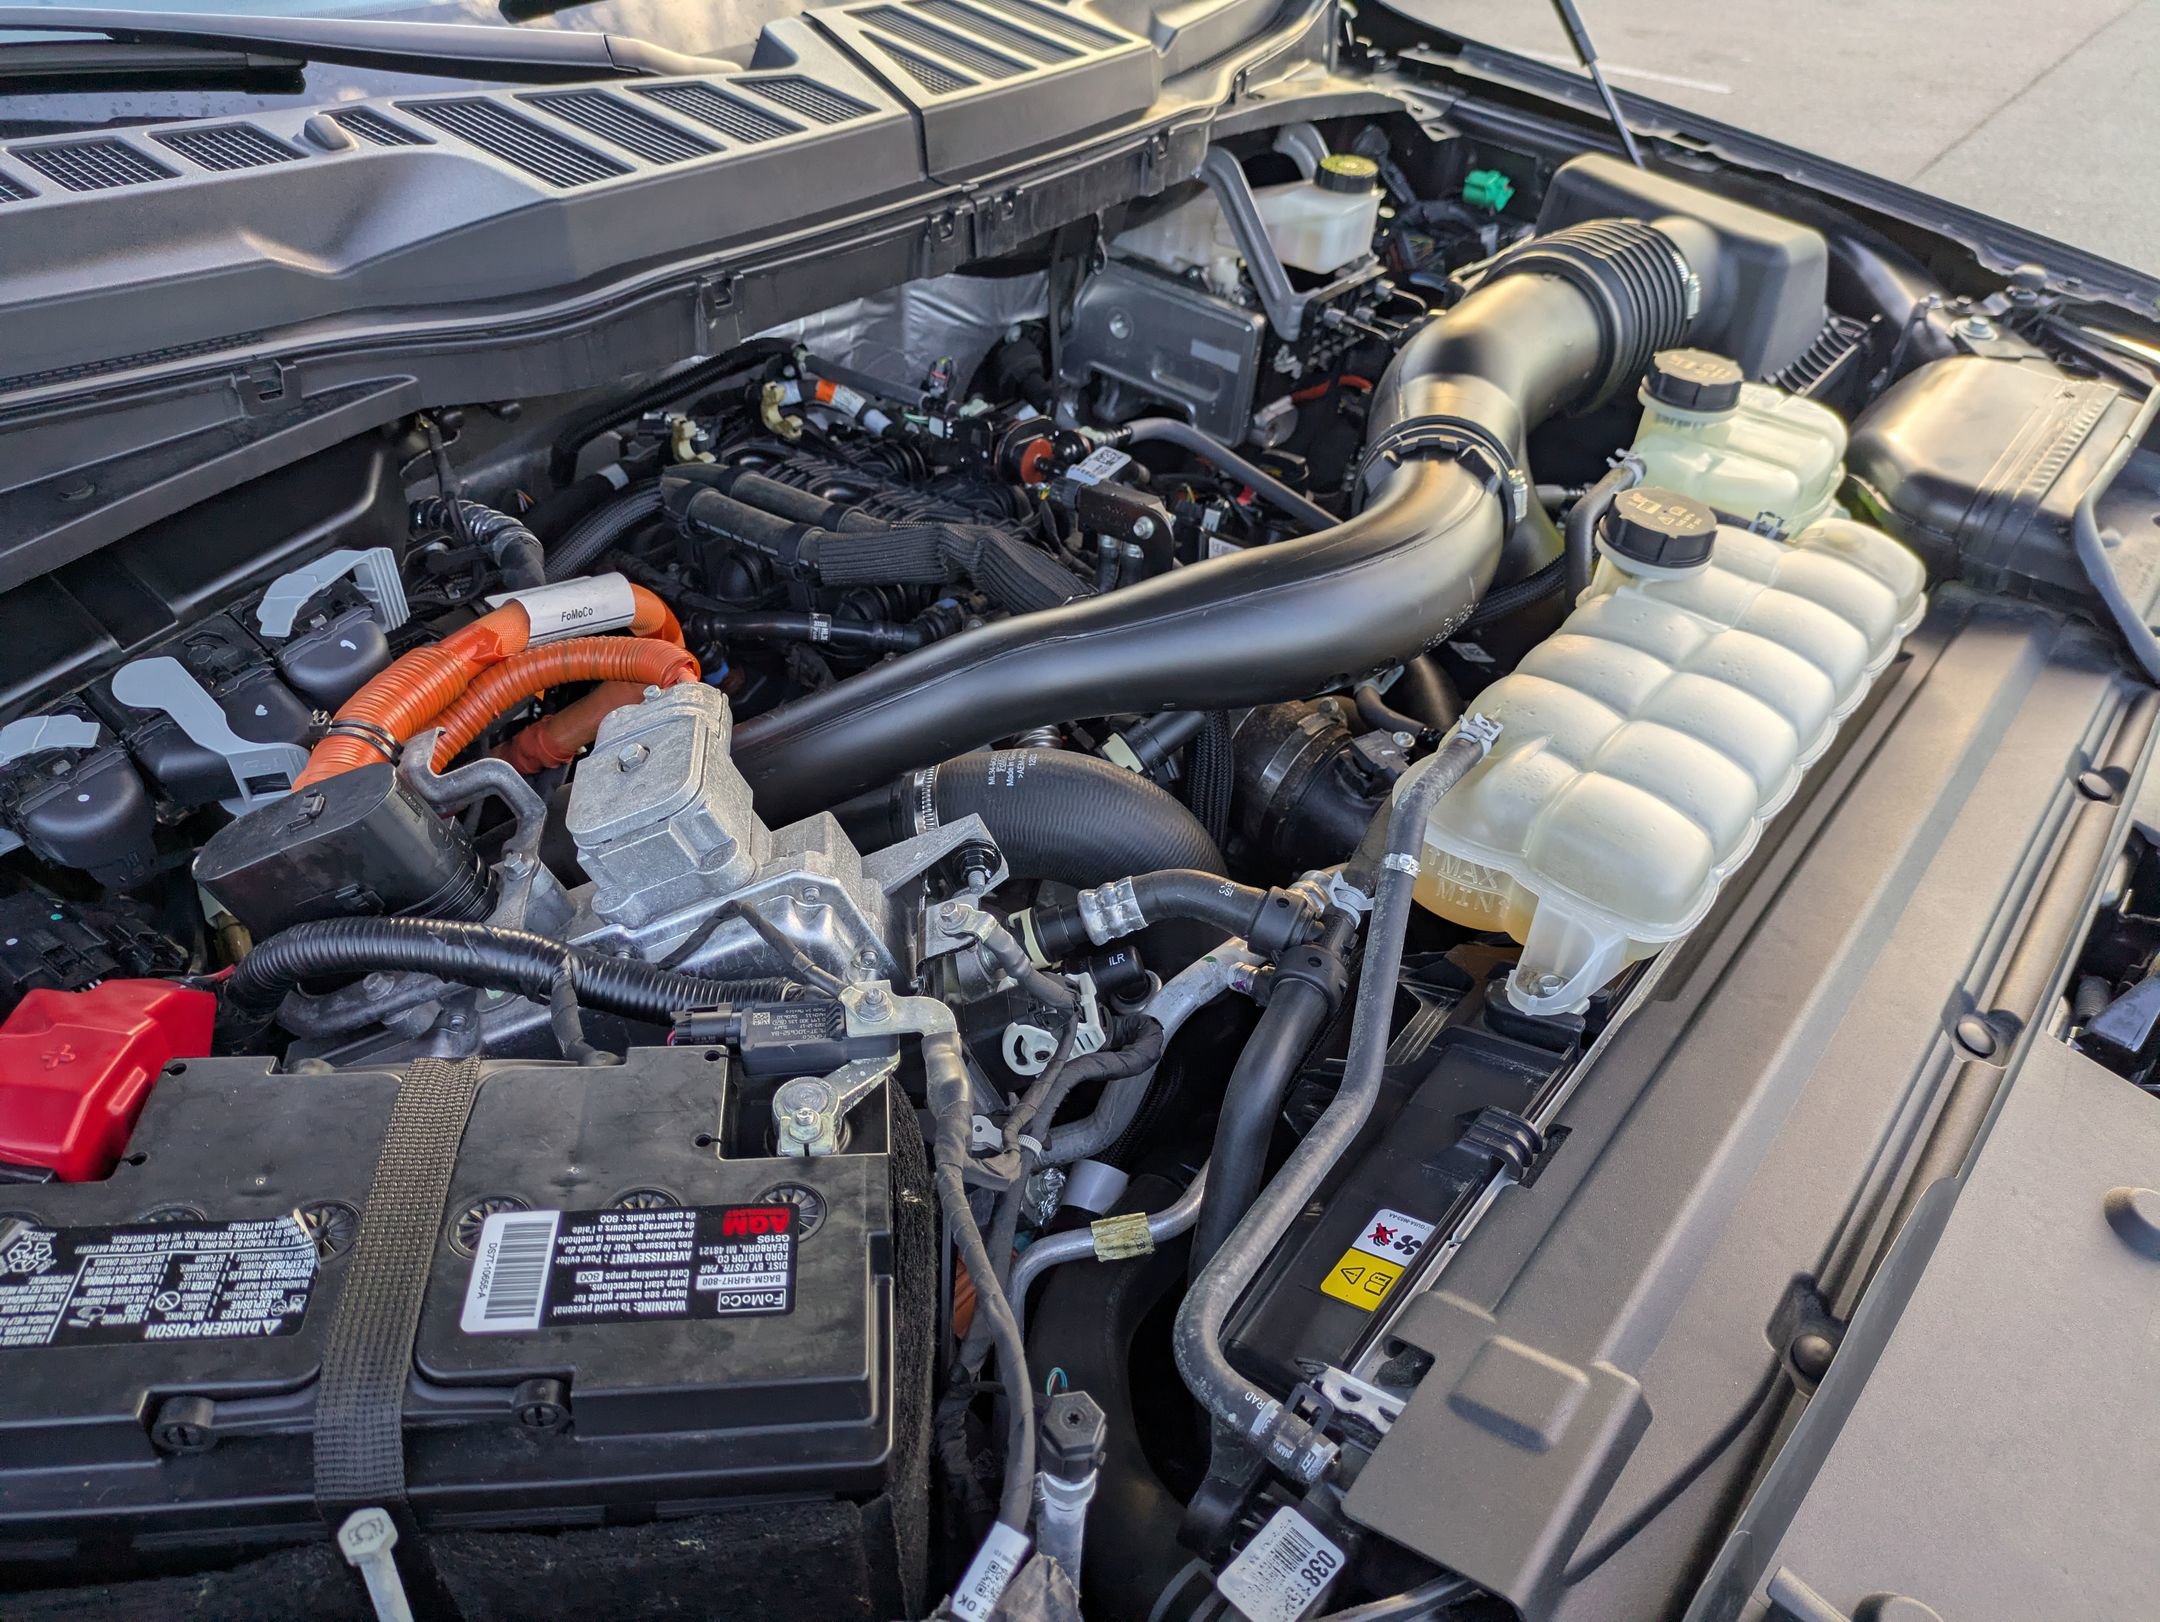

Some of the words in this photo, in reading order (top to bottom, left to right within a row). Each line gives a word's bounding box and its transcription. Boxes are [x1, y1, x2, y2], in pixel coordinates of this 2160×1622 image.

[561, 606, 593, 622] FoMoCo
[1006, 768, 1014, 786] Made
[1441, 855, 1500, 889] MAX
[1436, 879, 1495, 912] MIN
[1109, 953, 1125, 966] ILR
[600, 1215, 619, 1223] 800
[626, 1214, 655, 1222] volants
[658, 1212, 684, 1222] cables
[686, 1212, 696, 1220] de
[228, 1222, 264, 1231] BATTERIE!
[264, 1221, 274, 1229] LA
[605, 1224, 637, 1232] secours
[639, 1222, 682, 1232] demarrage
[684, 1222, 694, 1230] de
[722, 1215, 790, 1235] AGM
[272, 1230, 282, 1238] DE
[283, 1226, 300, 1236] HORS
[572, 1226, 595, 1234] l'aide
[156, 1233, 171, 1241] PAS
[172, 1232, 182, 1240] NE
[219, 1232, 233, 1240] DES
[262, 1231, 272, 1239] LA
[292, 1234, 302, 1245] OUT
[596, 1235, 603, 1243] la
[645, 1230, 694, 1242] proprietaire
[757, 1234, 790, 1243] G519S
[233, 1240, 243, 1248] OF
[244, 1239, 266, 1248] REACH
[267, 1238, 279, 1247] THE
[280, 1238, 290, 1246] OF
[558, 1236, 594, 1245] methode
[678, 1241, 692, 1249] des
[109, 1245, 128, 1253] OPEN
[129, 1244, 144, 1252] NOT
[144, 1244, 155, 1252] DO
[170, 1242, 184, 1250] NOT
[565, 1246, 575, 1254] du
[578, 1244, 601, 1254] guide
[603, 1244, 611, 1252] le
[614, 1243, 631, 1252] Voir
[634, 1242, 676, 1251] blessures.
[699, 1246, 724, 1255] 48121
[726, 1245, 737, 1254] MI
[740, 1243, 789, 1253] DEARBORN,
[153, 1255, 165, 1264] DES
[194, 1255, 217, 1263] FUMER
[218, 1254, 226, 1262] DE
[236, 1254, 261, 1262] AVEUGLE
[555, 1256, 580, 1264] eviter
[582, 1255, 601, 1263] Pour
[610, 1251, 691, 1264] AVERTISSEMENT
[715, 1255, 729, 1263] CO.
[732, 1253, 763, 1262] MOTOR
[765, 1252, 788, 1261] FORD
[211, 1263, 223, 1271] LES
[238, 1262, 266, 1270] PEUVENT
[266, 1260, 302, 1270] EXPLOSIFS
[302, 1259, 315, 1268] GAZ
[721, 1263, 749, 1272] DISTR.
[753, 1262, 764, 1271] BY
[766, 1261, 788, 1270] DIST.
[116, 1266, 123, 1274] LA
[124, 1265, 146, 1274] CAUSER
[146, 1264, 162, 1273] PEUT
[477, 1242, 497, 1299] DS7T-10655-A
[700, 1264, 718, 1273] PAR
[228, 1272, 242, 1280] LES
[242, 1270, 260, 1280] YEUX
[261, 1270, 273, 1279] LES
[580, 1273, 600, 1281] 800
[606, 1270, 629, 1280] amps
[631, 1269, 668, 1280] cranking
[670, 1269, 689, 1278] Cold
[272, 1279, 309, 1289] BLINDNESS
[645, 1280, 664, 1289] start
[666, 1278, 689, 1287] jump
[702, 1274, 781, 1286] BAGM-94RH7-800
[142, 1285, 153, 1294] OR
[178, 1282, 191, 1290] LES
[234, 1282, 260, 1290] INJURY
[261, 1281, 270, 1289] OR
[589, 1282, 642, 1291] instructions.
[86, 1288, 112, 1296] BURNS
[113, 1286, 141, 1295] SEVERE
[260, 1290, 283, 1299] GASES
[662, 1288, 687, 1298] injury
[135, 1295, 149, 1303] CAN
[182, 1292, 211, 1301] SMOKING
[222, 1292, 244, 1301] CAUSE
[245, 1291, 259, 1300] CAN
[573, 1294, 586, 1303] for
[589, 1291, 613, 1302] guide
[615, 1292, 642, 1300] owner
[721, 1293, 783, 1306] FoMoCo
[71, 1297, 110, 1306] BLINDNESS
[110, 1296, 134, 1305] CAUSE
[230, 1300, 272, 1309] EXPLOSIVE
[125, 1304, 146, 1313] ACID
[553, 1303, 592, 1316] personal
[595, 1303, 619, 1313] avoid
[621, 1303, 631, 1311] To
[633, 1301, 686, 1312] WARNING:
[101, 1313, 142, 1325] SULFURIC
[193, 1311, 205, 1321] NO
[220, 1310, 241, 1320] EYES
[242, 1310, 269, 1319] SHIELD
[145, 1321, 261, 1339] DANGER/POISON
[1245, 1392, 1266, 1410] RAD
[958, 1594, 976, 1611] OK
